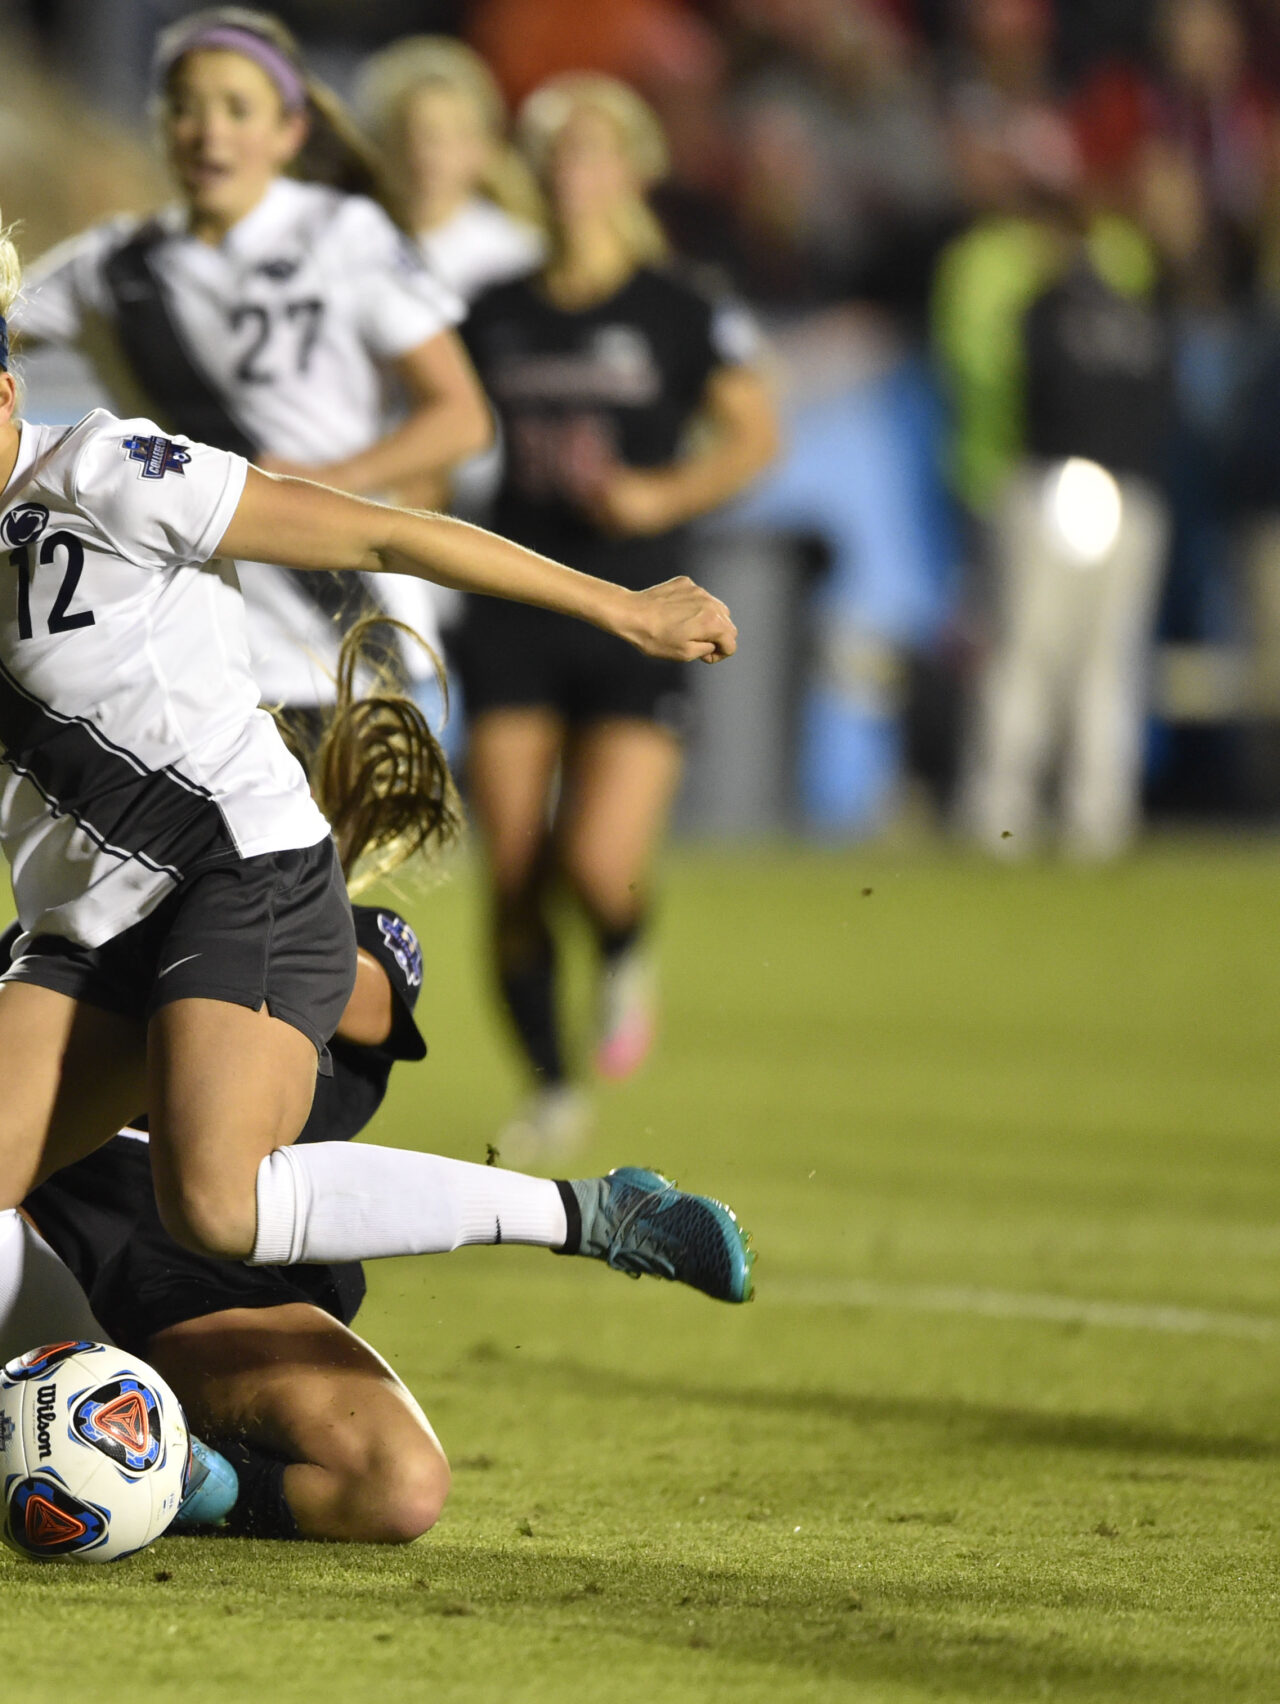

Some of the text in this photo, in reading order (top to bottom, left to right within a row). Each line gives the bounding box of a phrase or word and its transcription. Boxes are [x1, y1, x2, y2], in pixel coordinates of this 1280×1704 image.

[227, 301, 322, 384] 27
[9, 530, 95, 640] 12
[37, 1383, 56, 1461] Wilson
